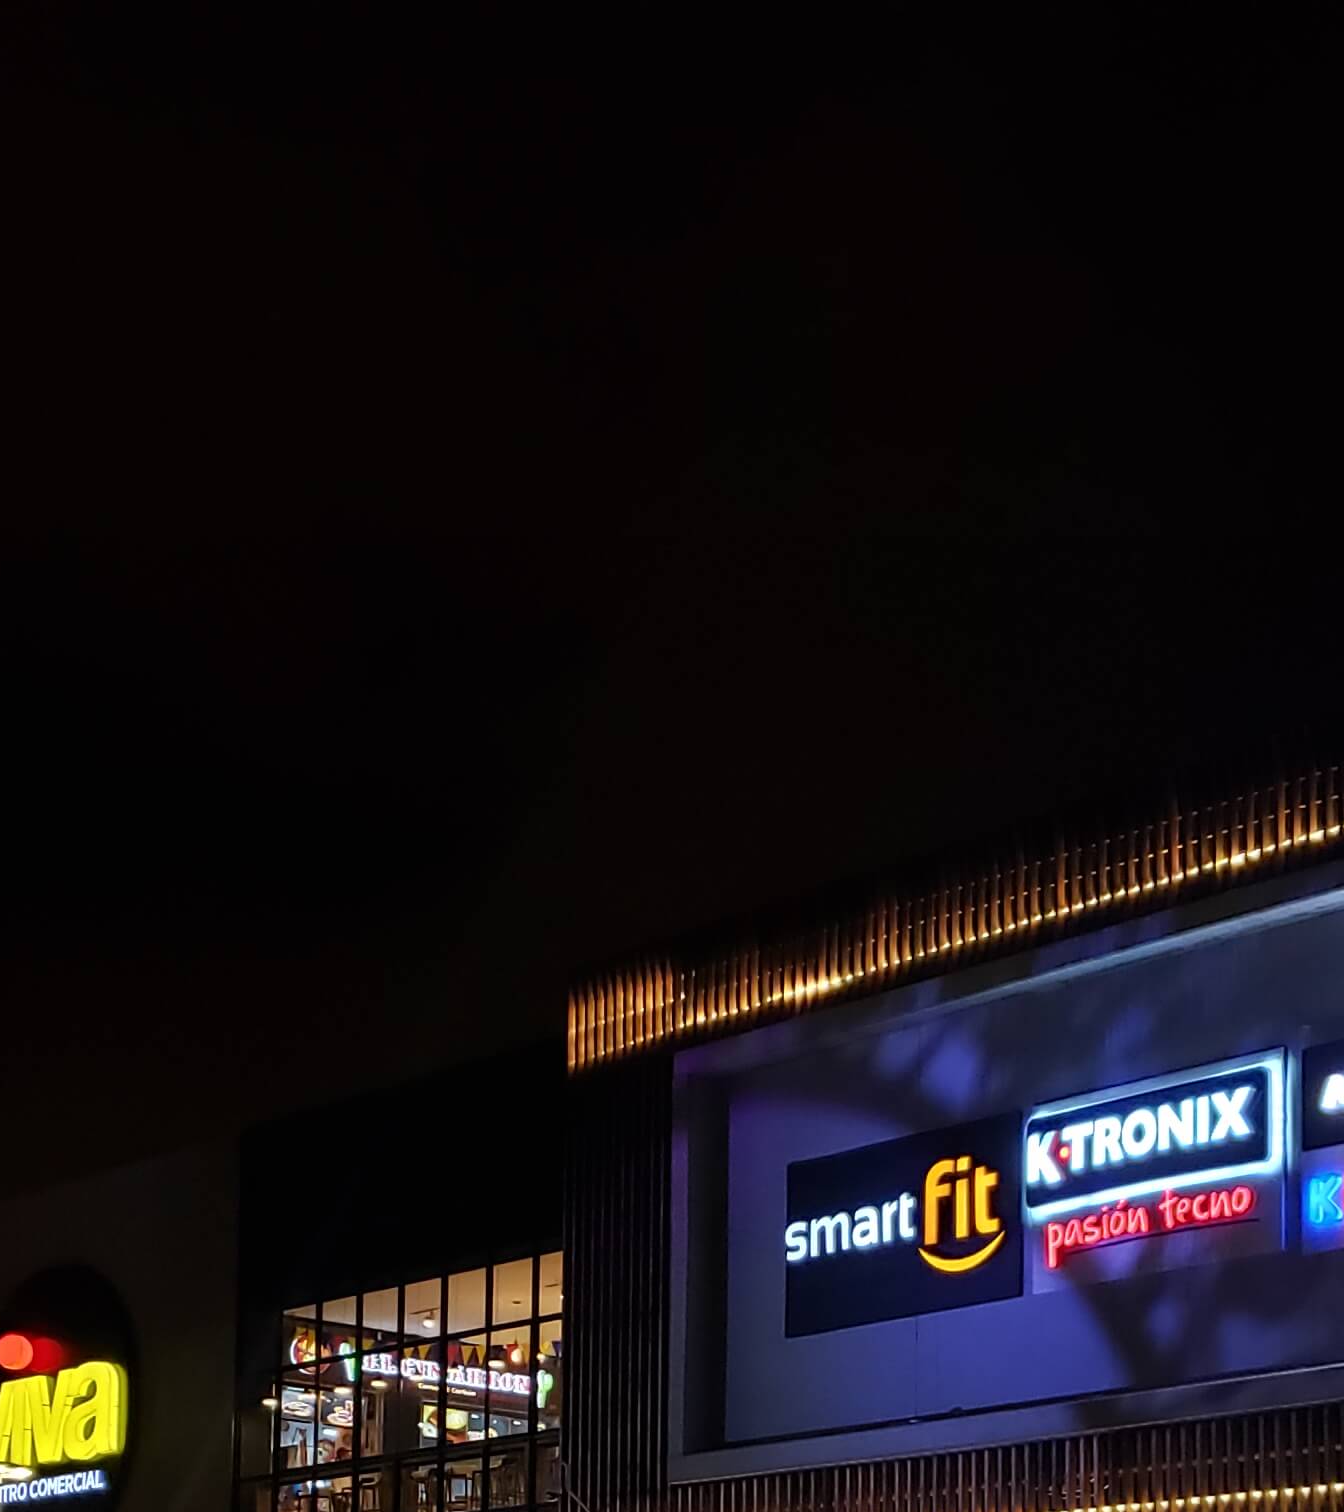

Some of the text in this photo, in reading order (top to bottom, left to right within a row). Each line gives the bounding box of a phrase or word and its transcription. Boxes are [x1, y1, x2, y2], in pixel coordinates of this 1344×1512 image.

[784, 1155, 1002, 1263] smart fit
[1044, 1186, 1255, 1269] pasión tecno
[29, 1469, 105, 1500] COMERCIAL
